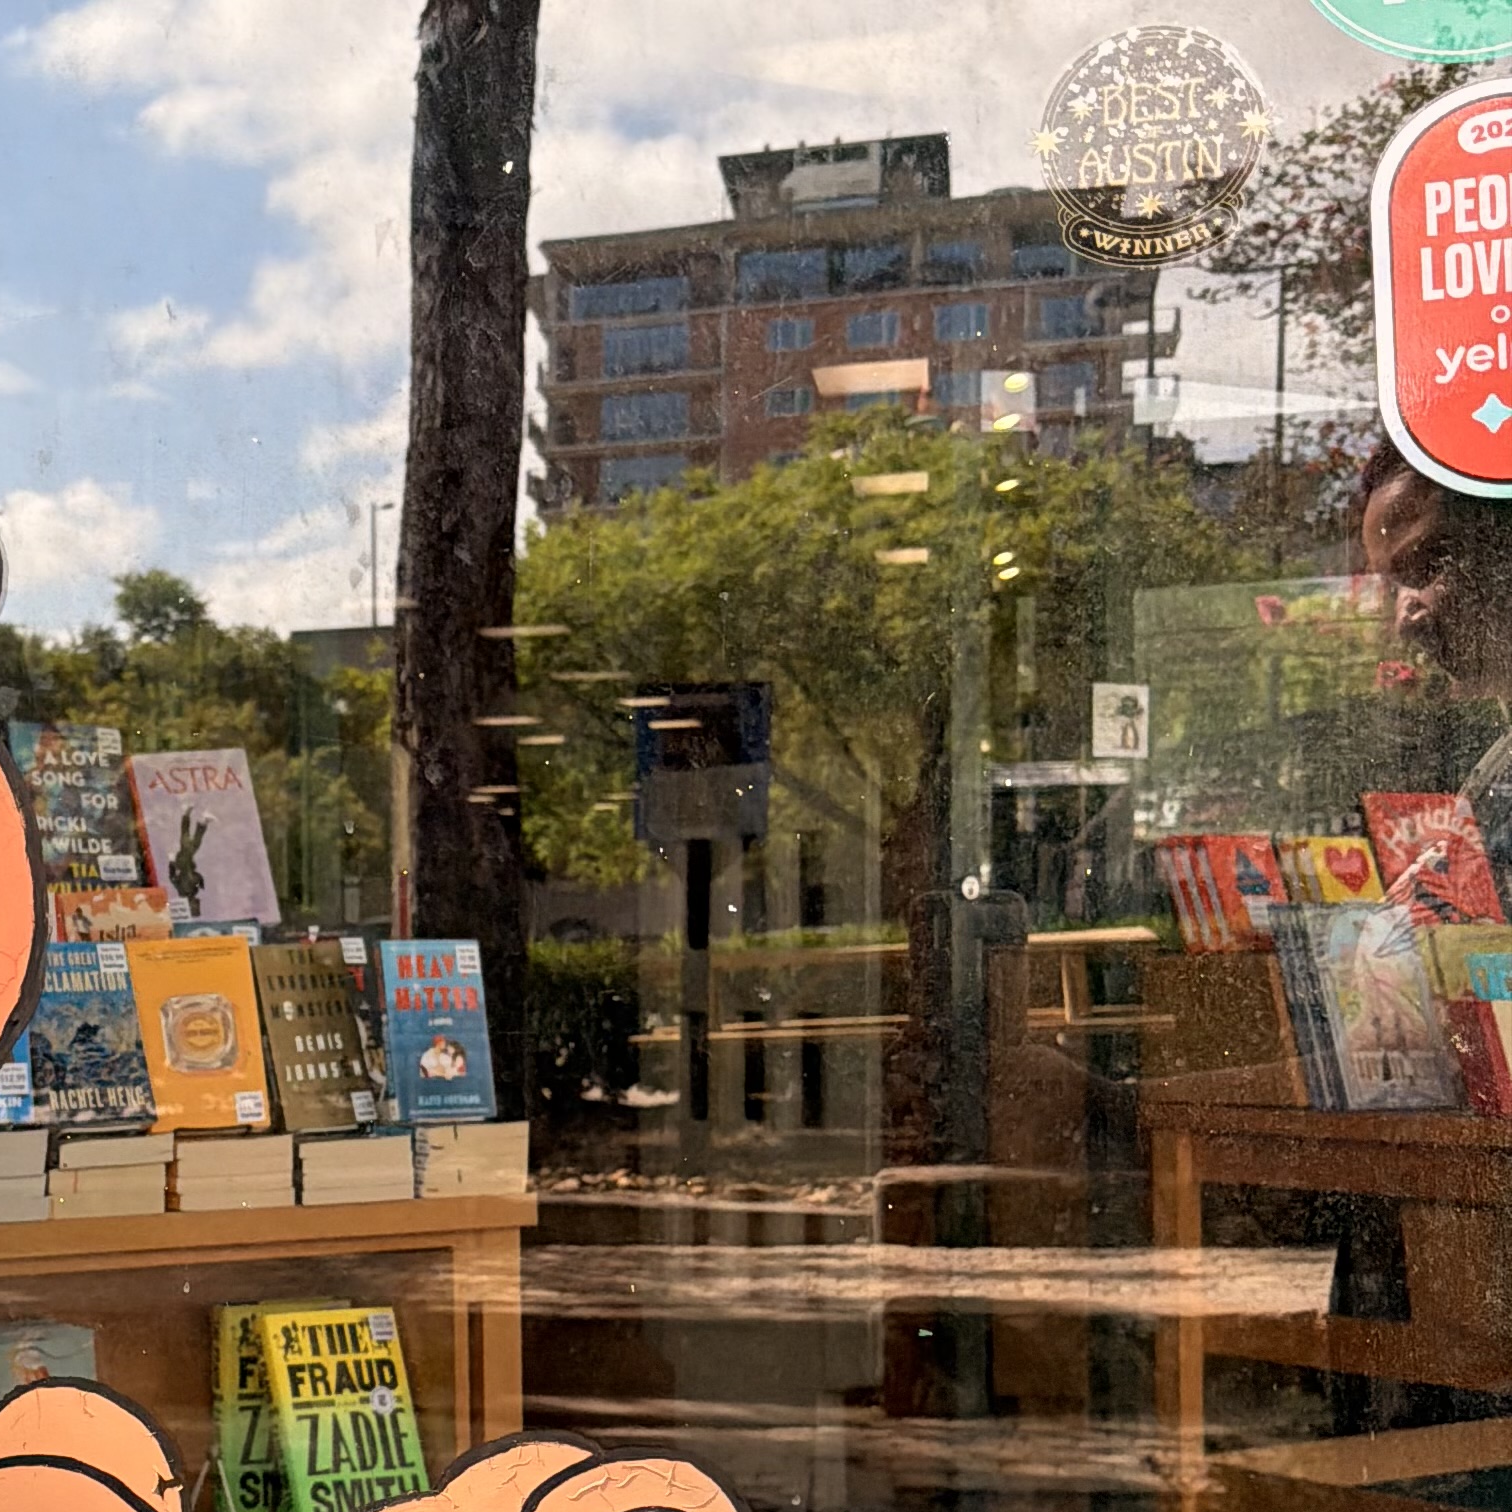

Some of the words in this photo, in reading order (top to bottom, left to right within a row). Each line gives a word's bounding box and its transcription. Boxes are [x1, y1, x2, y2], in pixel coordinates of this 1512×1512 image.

[1103, 77, 1206, 125] BEST
[1078, 134, 1223, 189] AUSTIN
[1424, 174, 1512, 237] PEO
[1093, 223, 1212, 256] WINNER
[1490, 305, 1511, 323] o
[1435, 332, 1510, 384] yel
[44, 751, 57, 765] A
[61, 751, 110, 767] LOVE
[31, 770, 85, 787] SONG
[148, 766, 243, 794] ASTRA
[80, 793, 119, 810] FOR
[36, 815, 87, 832] RICKI
[50, 836, 113, 854] WILDE
[70, 862, 99, 877] TIA
[397, 954, 469, 978] HEAV
[44, 970, 127, 992] CLAMATION
[49, 1088, 104, 1111] RACHEL
[108, 1086, 146, 1108] HENG
[301, 1321, 370, 1357] THE
[287, 1358, 399, 1398] FRAUD
[297, 1408, 416, 1476] ZADIE
